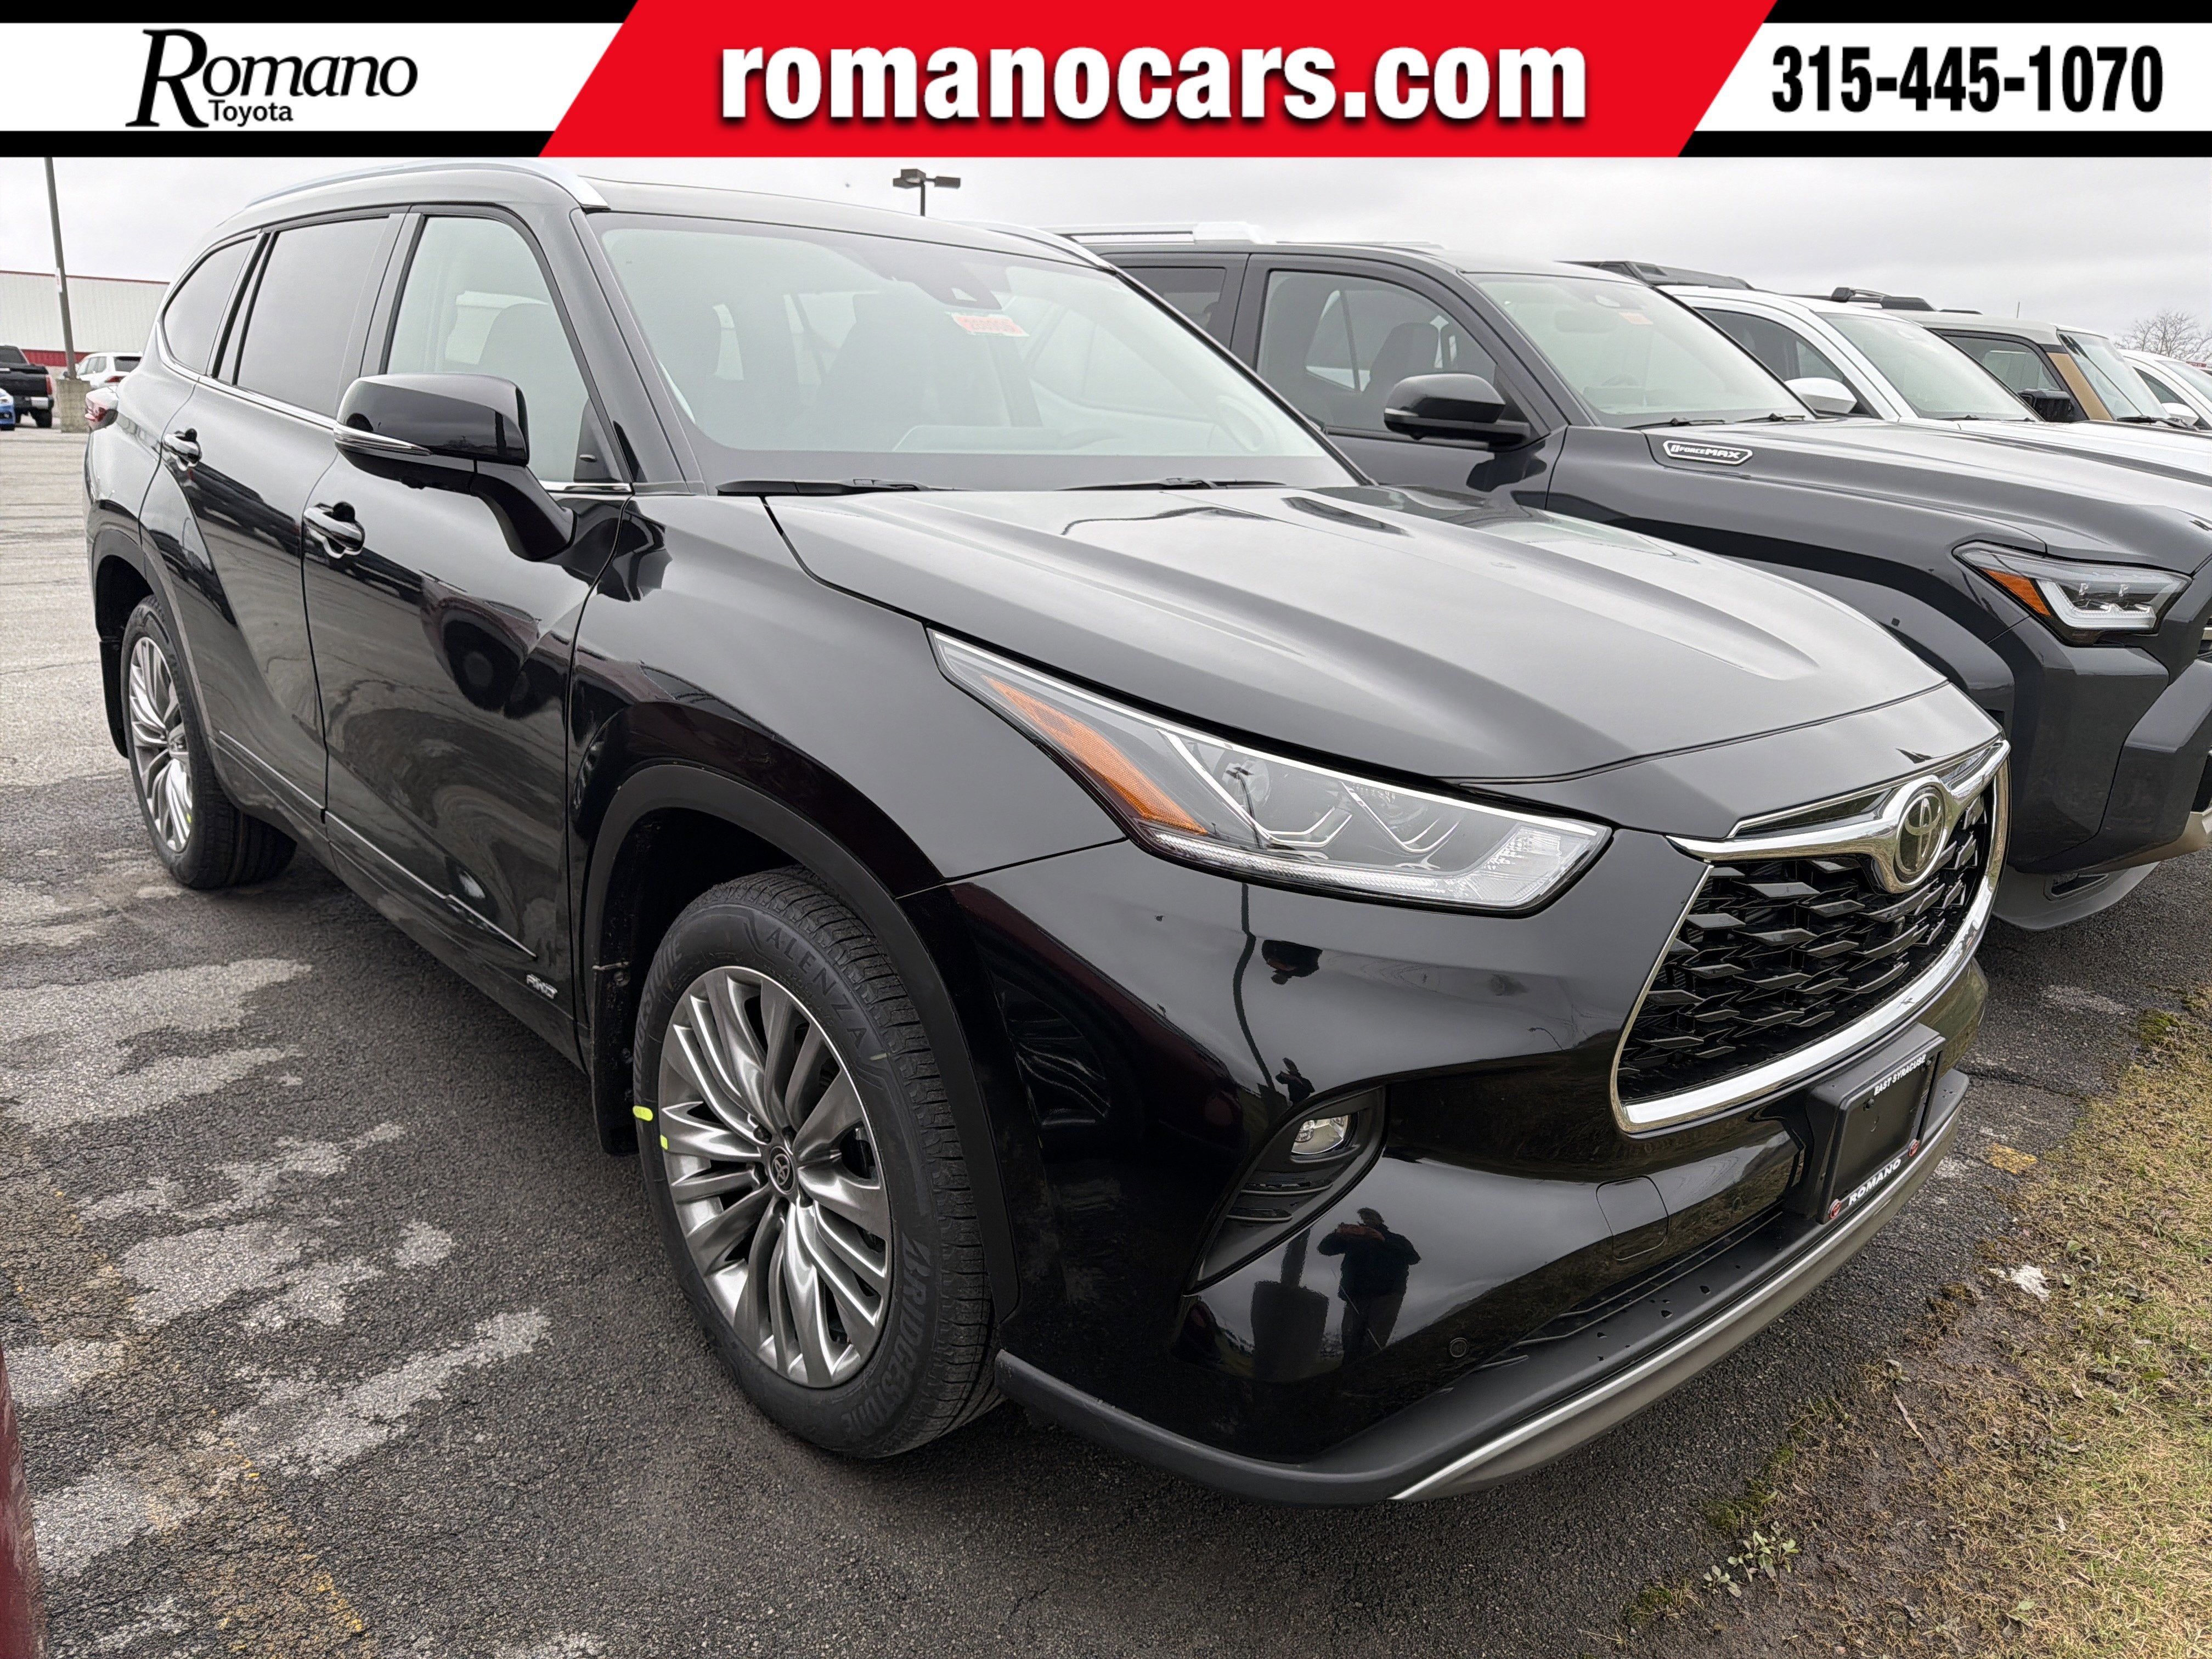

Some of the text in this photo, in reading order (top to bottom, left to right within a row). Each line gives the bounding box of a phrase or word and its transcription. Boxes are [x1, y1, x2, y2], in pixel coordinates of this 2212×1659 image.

[766, 928, 867, 1049] ALENZA
[1874, 1054, 1927, 1096] EAST SYRACUSE
[1848, 1159, 1901, 1206] ROMANO
